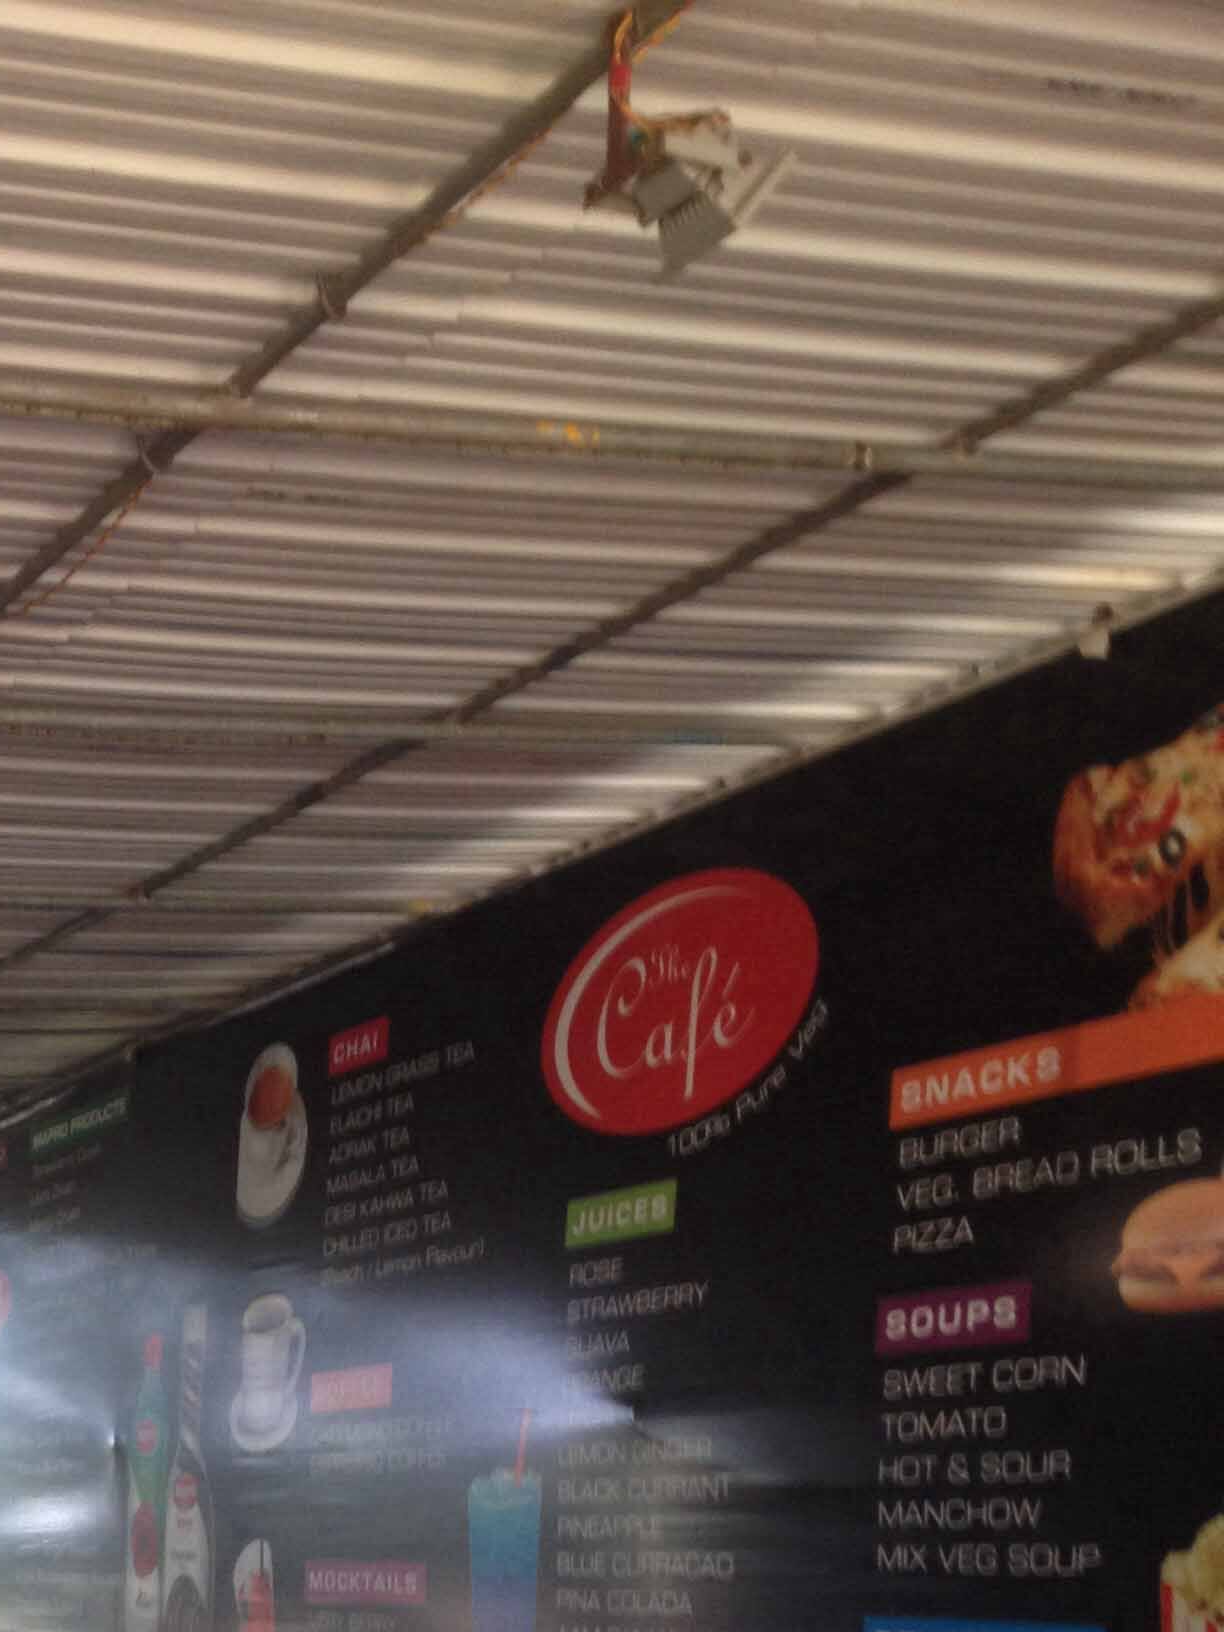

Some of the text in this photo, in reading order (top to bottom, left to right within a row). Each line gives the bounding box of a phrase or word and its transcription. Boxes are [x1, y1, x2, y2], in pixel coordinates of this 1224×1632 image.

[597, 947, 755, 1100] Café
[333, 1032, 380, 1064] CHAI
[445, 1040, 475, 1065] TEA
[735, 1063, 787, 1121] Pure
[900, 1046, 1062, 1113] SNACKS
[386, 1092, 415, 1118] TEA
[382, 1127, 411, 1151] TEA
[898, 1116, 1023, 1169] BURGER
[391, 1154, 420, 1180] TEA
[972, 1151, 1080, 1198] BREAD
[1091, 1127, 1202, 1178] ROLLS
[419, 1180, 449, 1204] TEA
[422, 1210, 452, 1235] TEA
[572, 1194, 668, 1236] JUICES
[892, 1215, 974, 1254] PIZZA
[568, 1280, 710, 1322] STRAWBERRY
[885, 1295, 1017, 1341] SOUPS
[882, 1353, 1088, 1400] SWEET CORN
[881, 1406, 1007, 1442] TOMATO
[879, 1448, 1072, 1487] HOT & SOUR
[878, 1497, 1041, 1529] MANCHOW
[557, 1551, 607, 1578] BLUE
[877, 1542, 1103, 1577] MIX VEG SOUP
[309, 1570, 417, 1599] MOCKTAILS
